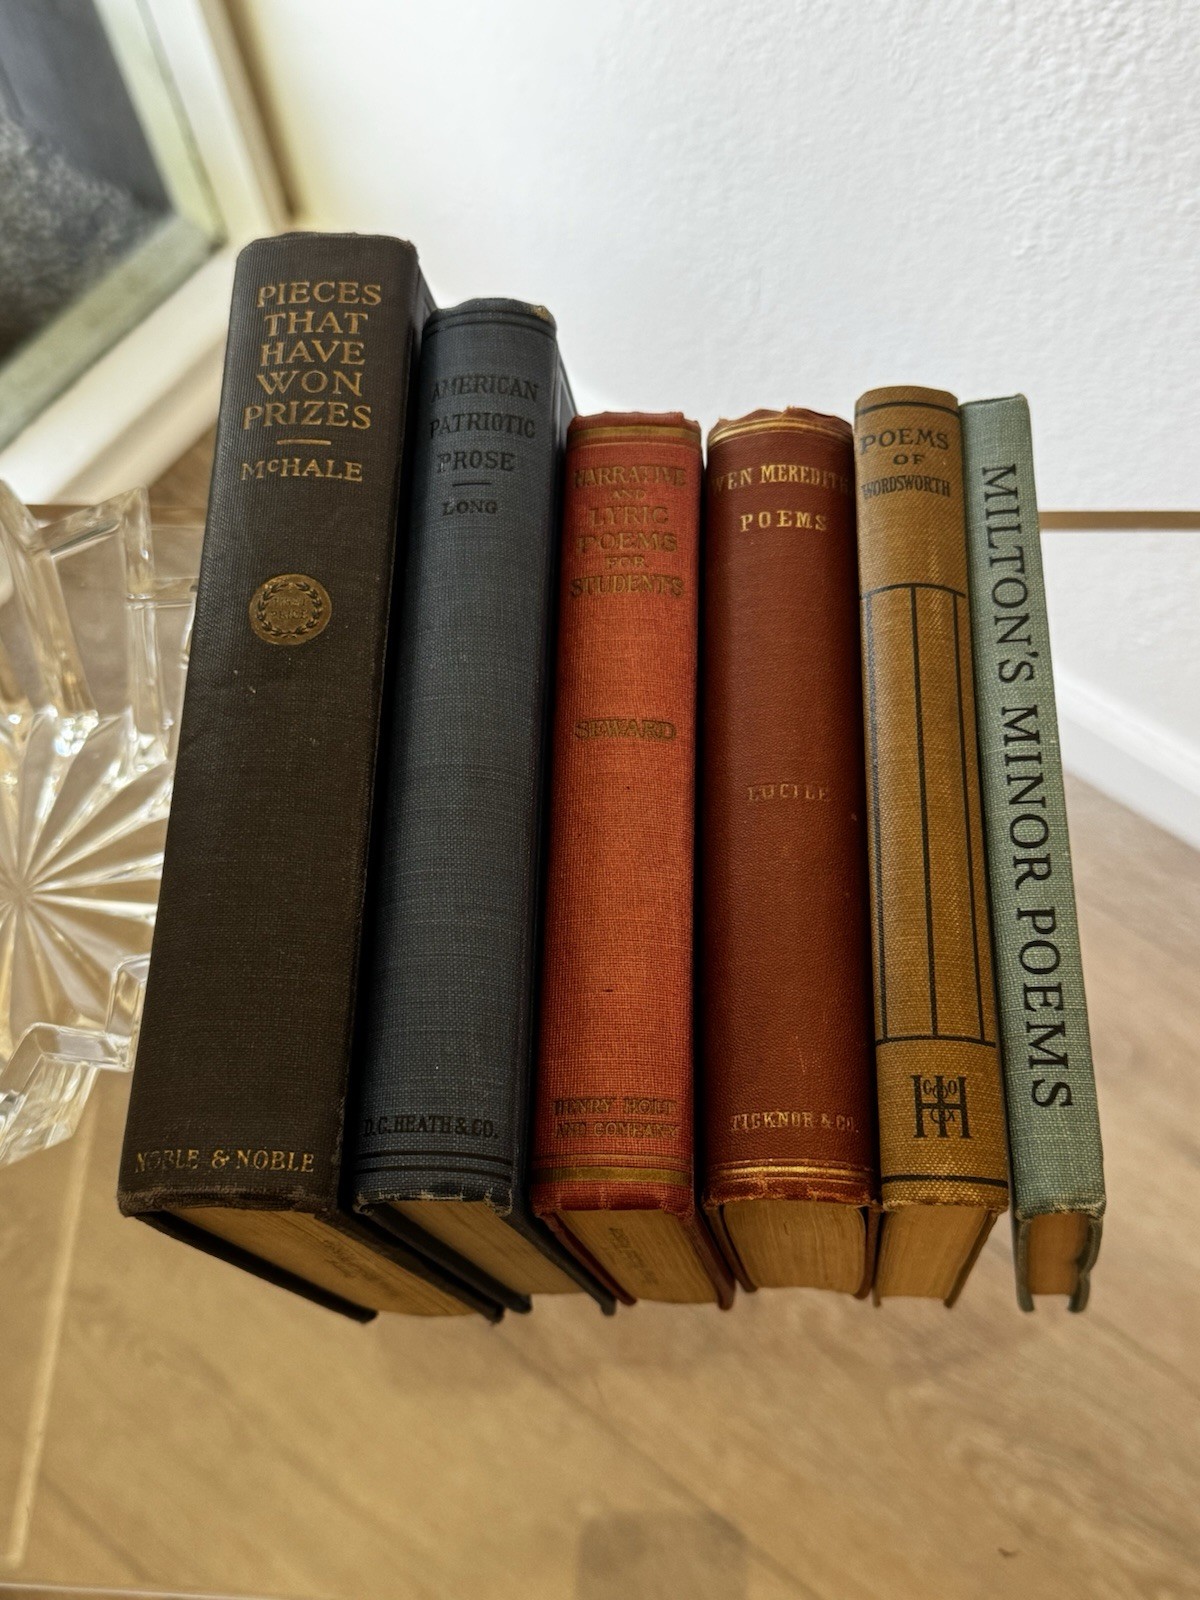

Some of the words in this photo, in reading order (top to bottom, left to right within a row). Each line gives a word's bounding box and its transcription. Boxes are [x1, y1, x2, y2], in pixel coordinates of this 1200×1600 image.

[256, 281, 382, 308] PIECES
[264, 310, 369, 337] THAT
[259, 340, 367, 367] HAVE
[256, 370, 363, 398] WON
[432, 373, 542, 401] AMERICAN
[243, 400, 373, 431] PRIZES
[428, 412, 537, 440] PATRIOTIC
[859, 427, 951, 454] POEMS
[436, 450, 517, 474] PROSE
[892, 454, 926, 466] OF
[573, 463, 687, 490] NARRATIVE
[860, 474, 952, 499] WORDSWORTH
[441, 499, 498, 518] LONG
[609, 488, 648, 502] AND
[588, 505, 669, 529] LYRIC
[740, 509, 828, 532] POEMS
[576, 530, 678, 555] POEMS
[604, 554, 649, 571] FOR
[981, 463, 1036, 685] MILTON'S
[569, 573, 686, 600] STUDENTS
[573, 717, 677, 742] SEWARD
[1001, 704, 1053, 890] MINOR
[1016, 906, 1074, 1109] POEMS
[592, 1120, 682, 1141] COMPANY
[730, 1110, 814, 1133] TICKNOR
[820, 1112, 834, 1129] &
[210, 1148, 231, 1170] &
[235, 1147, 315, 1174] NOBLE
